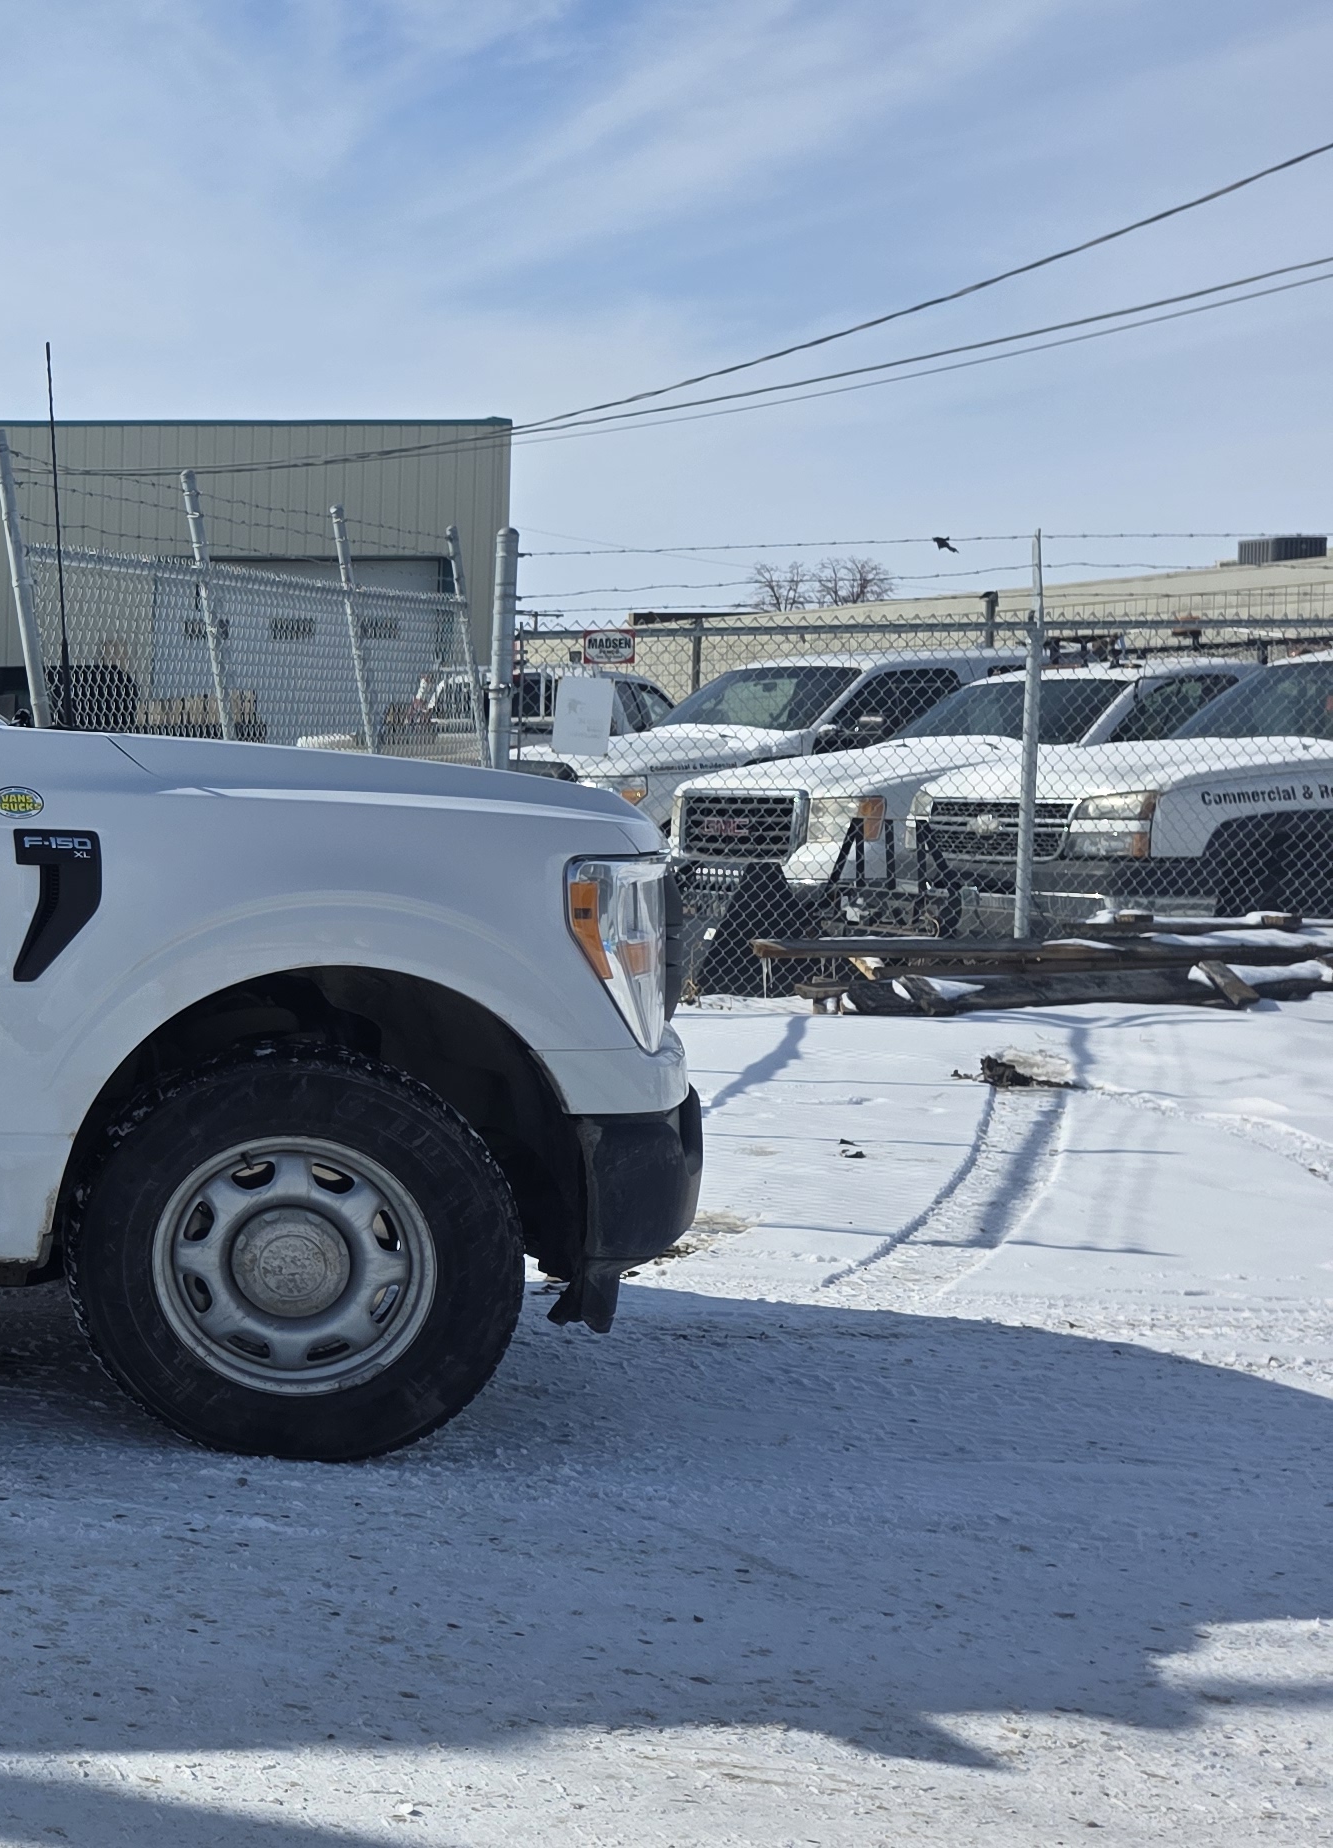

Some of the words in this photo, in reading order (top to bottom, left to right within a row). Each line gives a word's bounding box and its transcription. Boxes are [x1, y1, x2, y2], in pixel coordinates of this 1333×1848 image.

[588, 637, 631, 649] MADSEN
[1, 794, 33, 803] VANS
[1201, 786, 1297, 806] Commercial
[1302, 784, 1313, 799] &
[703, 818, 749, 836] GMC
[23, 836, 92, 850] F-150
[73, 851, 91, 859] XL
